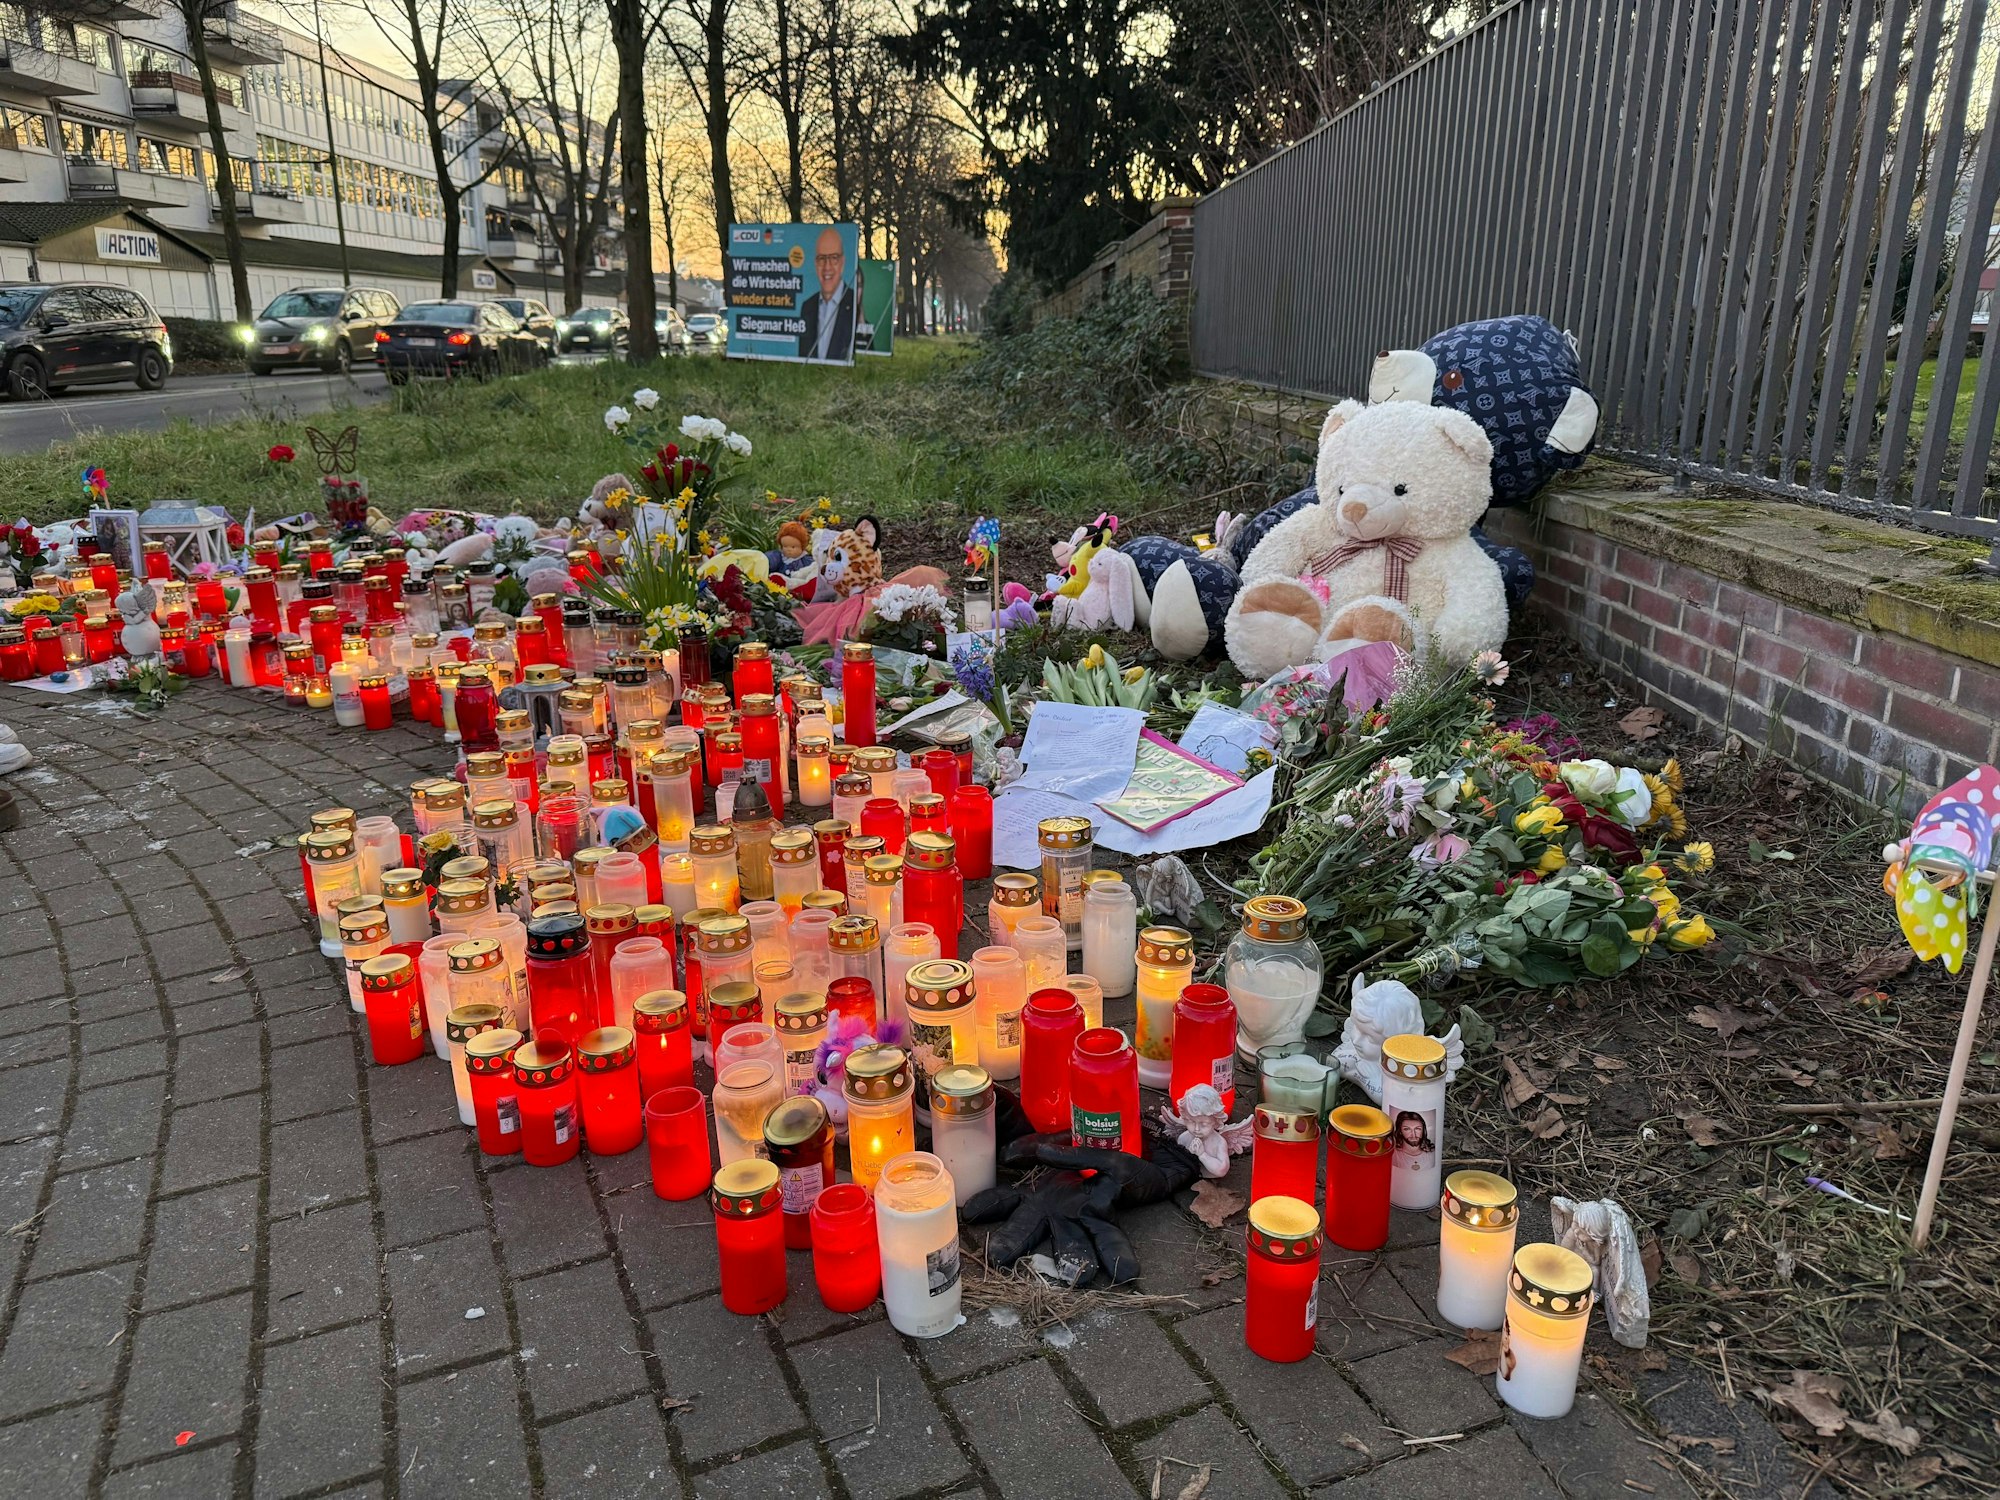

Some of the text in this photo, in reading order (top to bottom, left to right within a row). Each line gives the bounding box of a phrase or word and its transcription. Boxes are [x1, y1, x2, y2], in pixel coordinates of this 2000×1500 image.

[740, 231, 759, 241] CDU
[109, 234, 156, 257] ACTION
[732, 259, 790, 272] Wir machen
[732, 275, 801, 290] die Wirtschaft
[732, 292, 794, 307] wieder stark.
[741, 317, 806, 333] Siegmar Heß
[1085, 1116, 1119, 1128] bolsius
